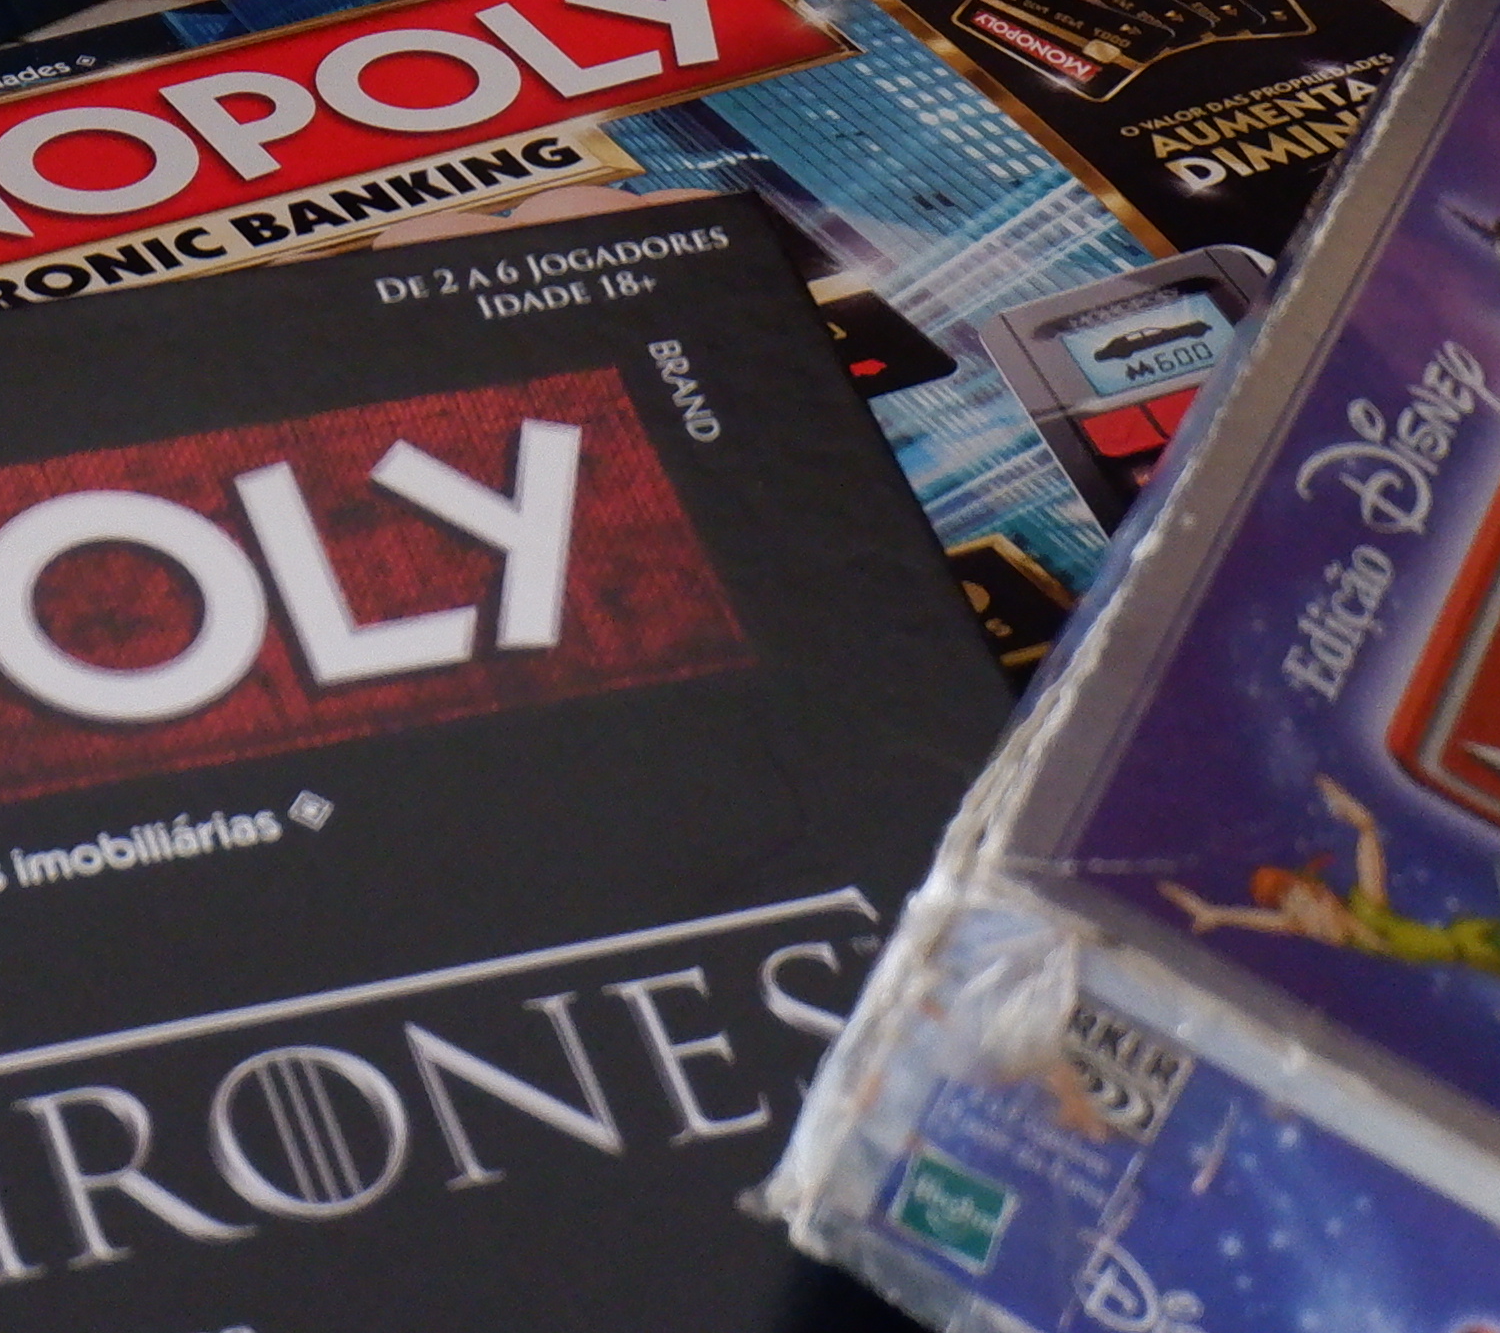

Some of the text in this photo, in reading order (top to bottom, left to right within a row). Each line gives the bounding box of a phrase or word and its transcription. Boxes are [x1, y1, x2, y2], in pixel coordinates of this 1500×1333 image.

[973, 12, 1092, 79] MONOPOLY
[1140, 104, 1203, 132] VALOR
[1203, 94, 1249, 116] DAS
[1249, 51, 1396, 103] PROPRIEDADES
[1150, 77, 1379, 160] AUMENTA
[1163, 103, 1370, 191] DIMIN
[230, 136, 583, 250] BANKING
[433, 267, 460, 296] 2
[496, 257, 519, 285] 6
[526, 225, 731, 285] JOGADORES
[476, 269, 659, 322] IDADE 18+
[646, 338, 724, 445] BRAND
[1281, 543, 1396, 704] Edição
[11, 803, 282, 894] imobiliárias
